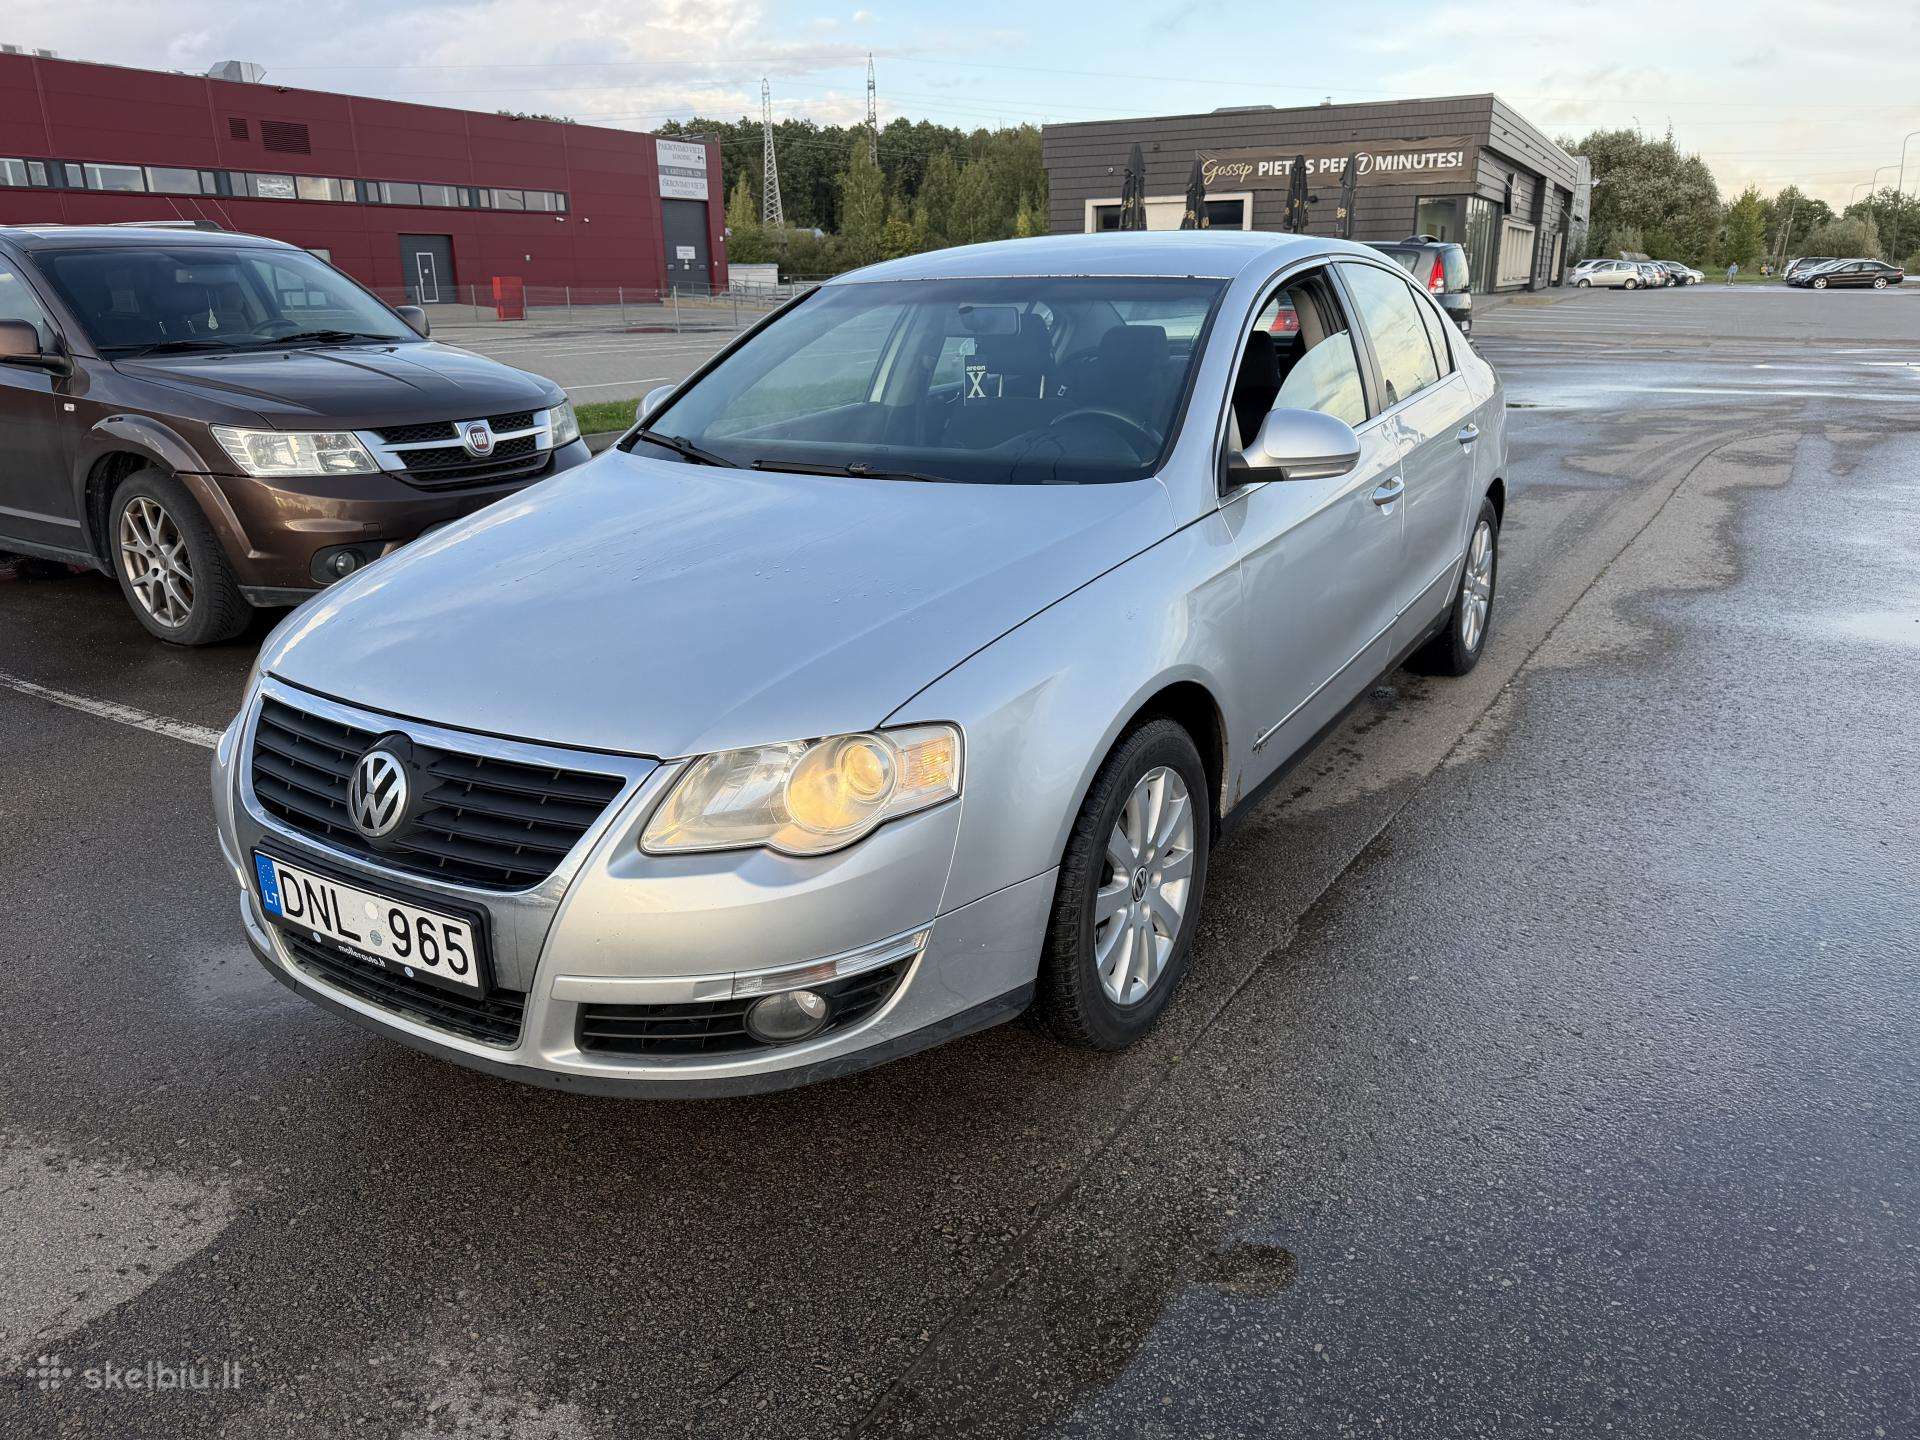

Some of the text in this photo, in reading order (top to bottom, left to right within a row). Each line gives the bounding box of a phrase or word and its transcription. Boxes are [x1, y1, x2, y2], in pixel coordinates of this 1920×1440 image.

[1201, 159, 1253, 185] Gossip
[1258, 159, 1315, 176] PIETS
[1375, 152, 1463, 171] MINUTES!
[967, 371, 986, 398] X
[264, 889, 279, 906] LT
[278, 869, 469, 976] DNL 965
